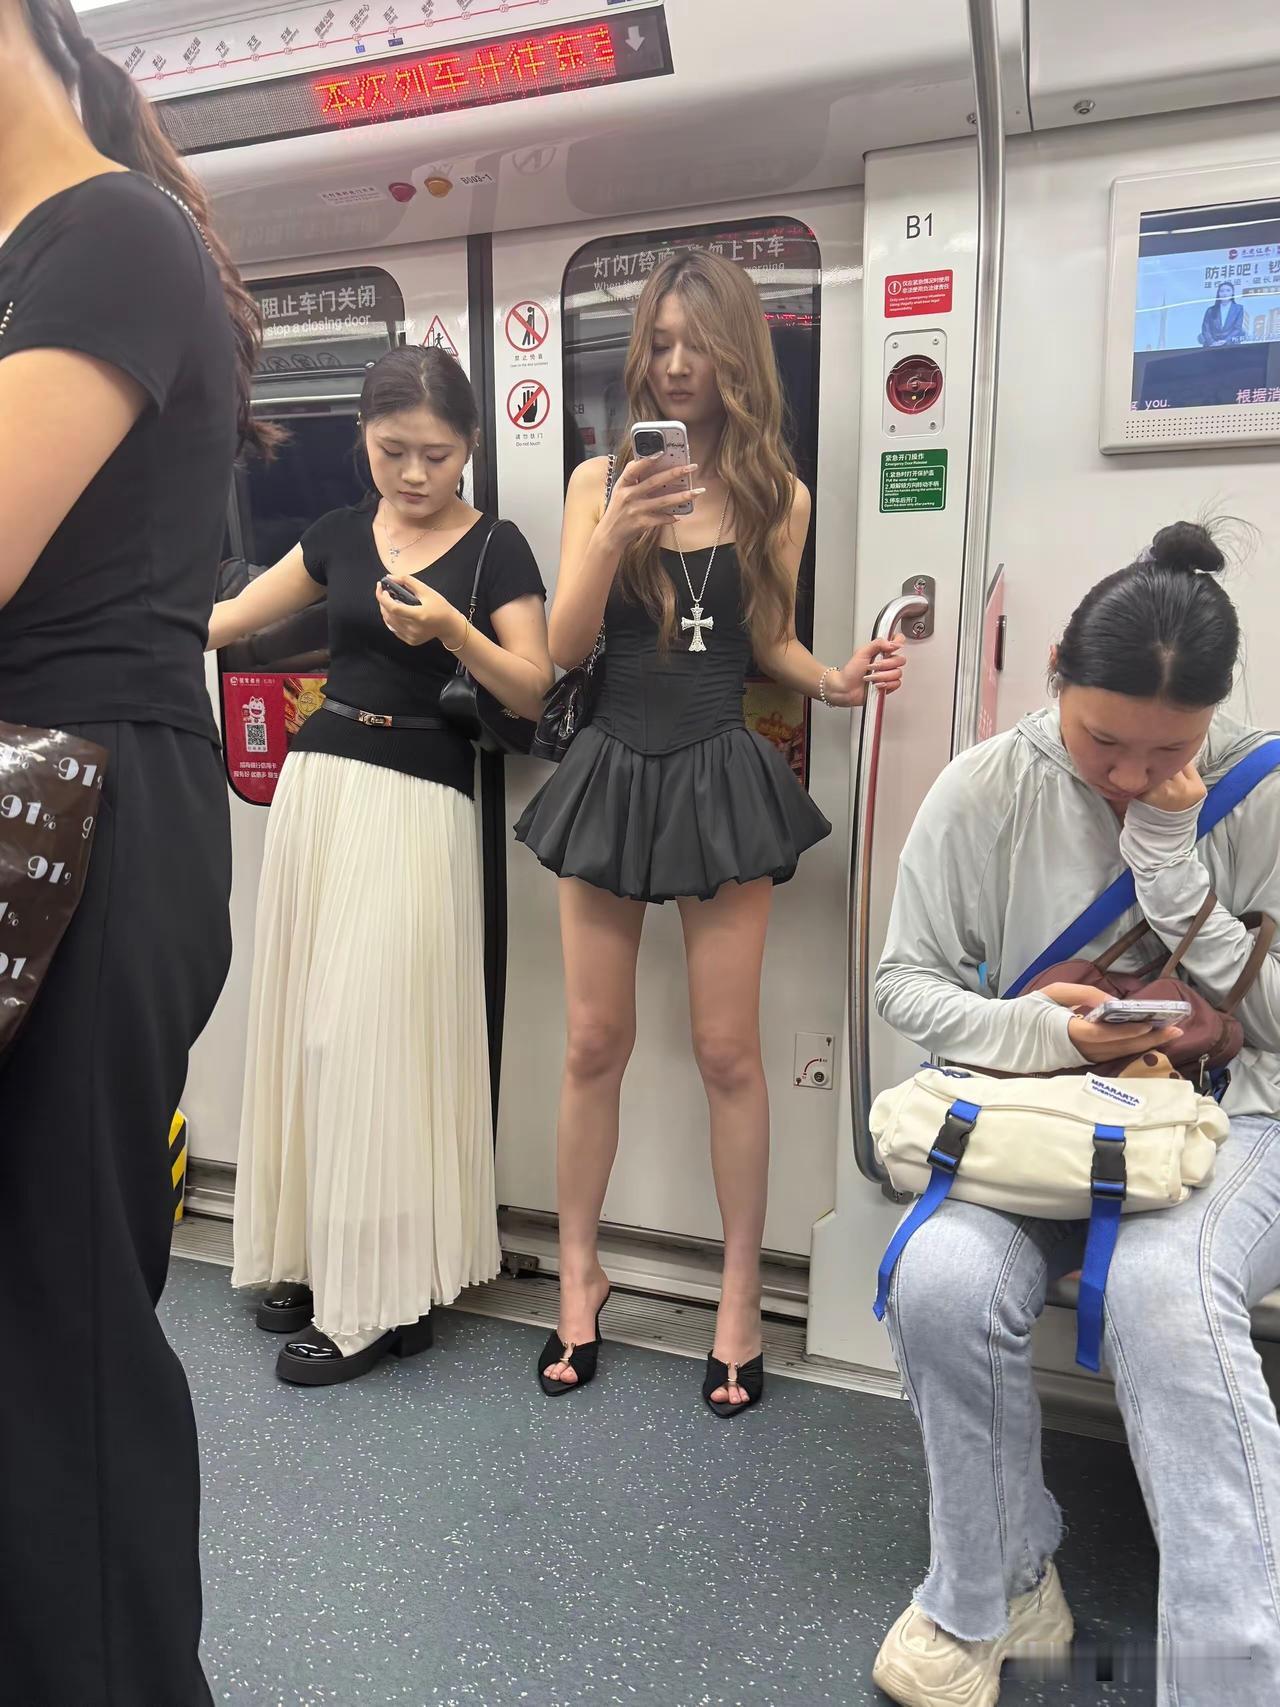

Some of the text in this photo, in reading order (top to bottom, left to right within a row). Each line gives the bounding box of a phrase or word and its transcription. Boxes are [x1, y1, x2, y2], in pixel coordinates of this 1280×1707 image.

[906, 212, 932, 239] B1
[687, 234, 785, 261] 勿上下车
[267, 313, 371, 337] stop a closing door
[1145, 399, 1171, 410] you.
[0, 794, 57, 830] 91%
